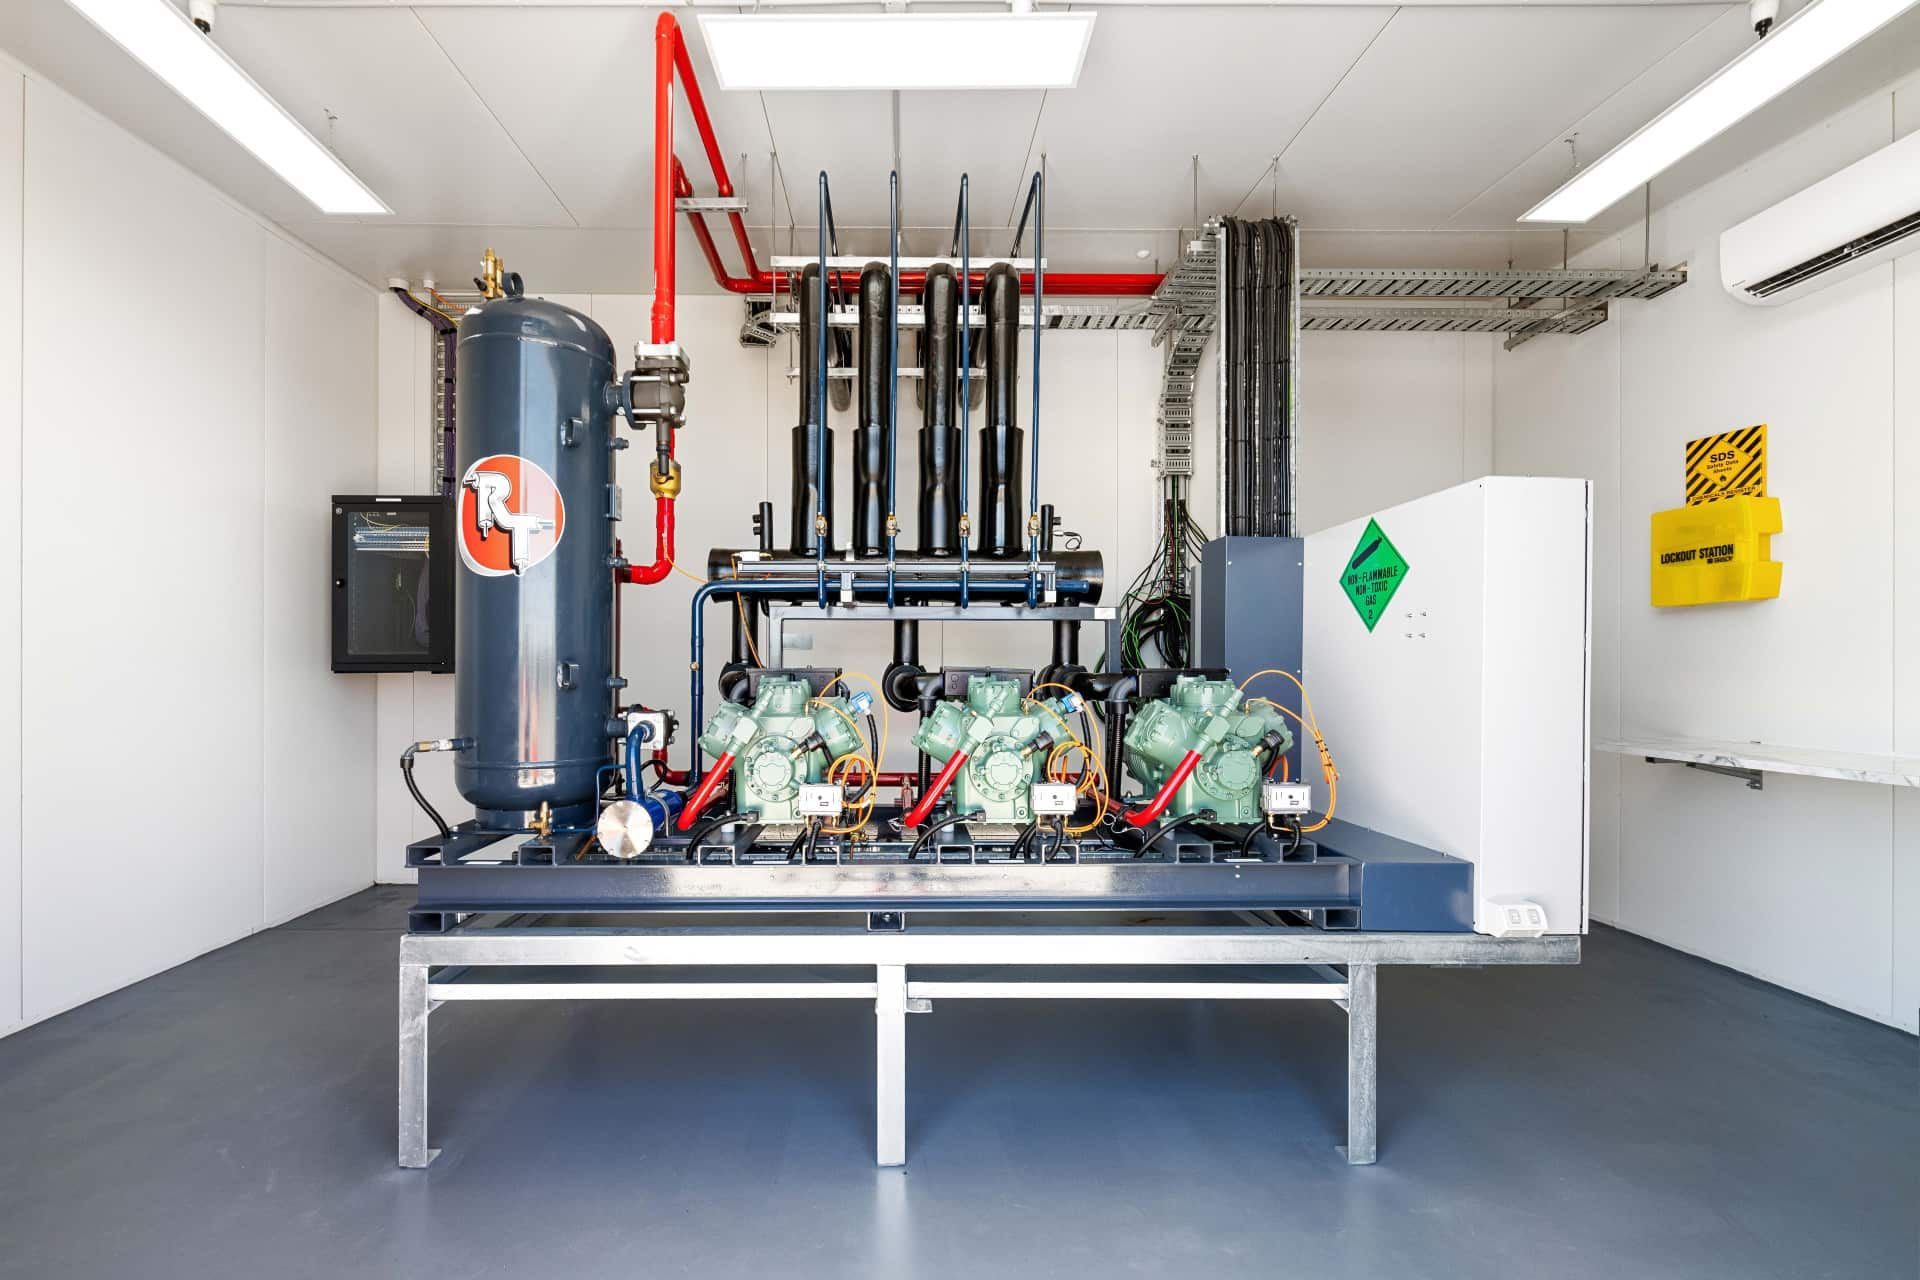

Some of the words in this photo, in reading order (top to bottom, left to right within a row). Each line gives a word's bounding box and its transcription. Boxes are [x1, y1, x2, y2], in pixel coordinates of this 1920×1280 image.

[1710, 451, 1735, 463] SDS
[1661, 549, 1696, 564] LOCKOUT
[1699, 544, 1733, 558] STATION
[1365, 595, 1376, 605] GAS
[1368, 609, 1373, 619] 2
